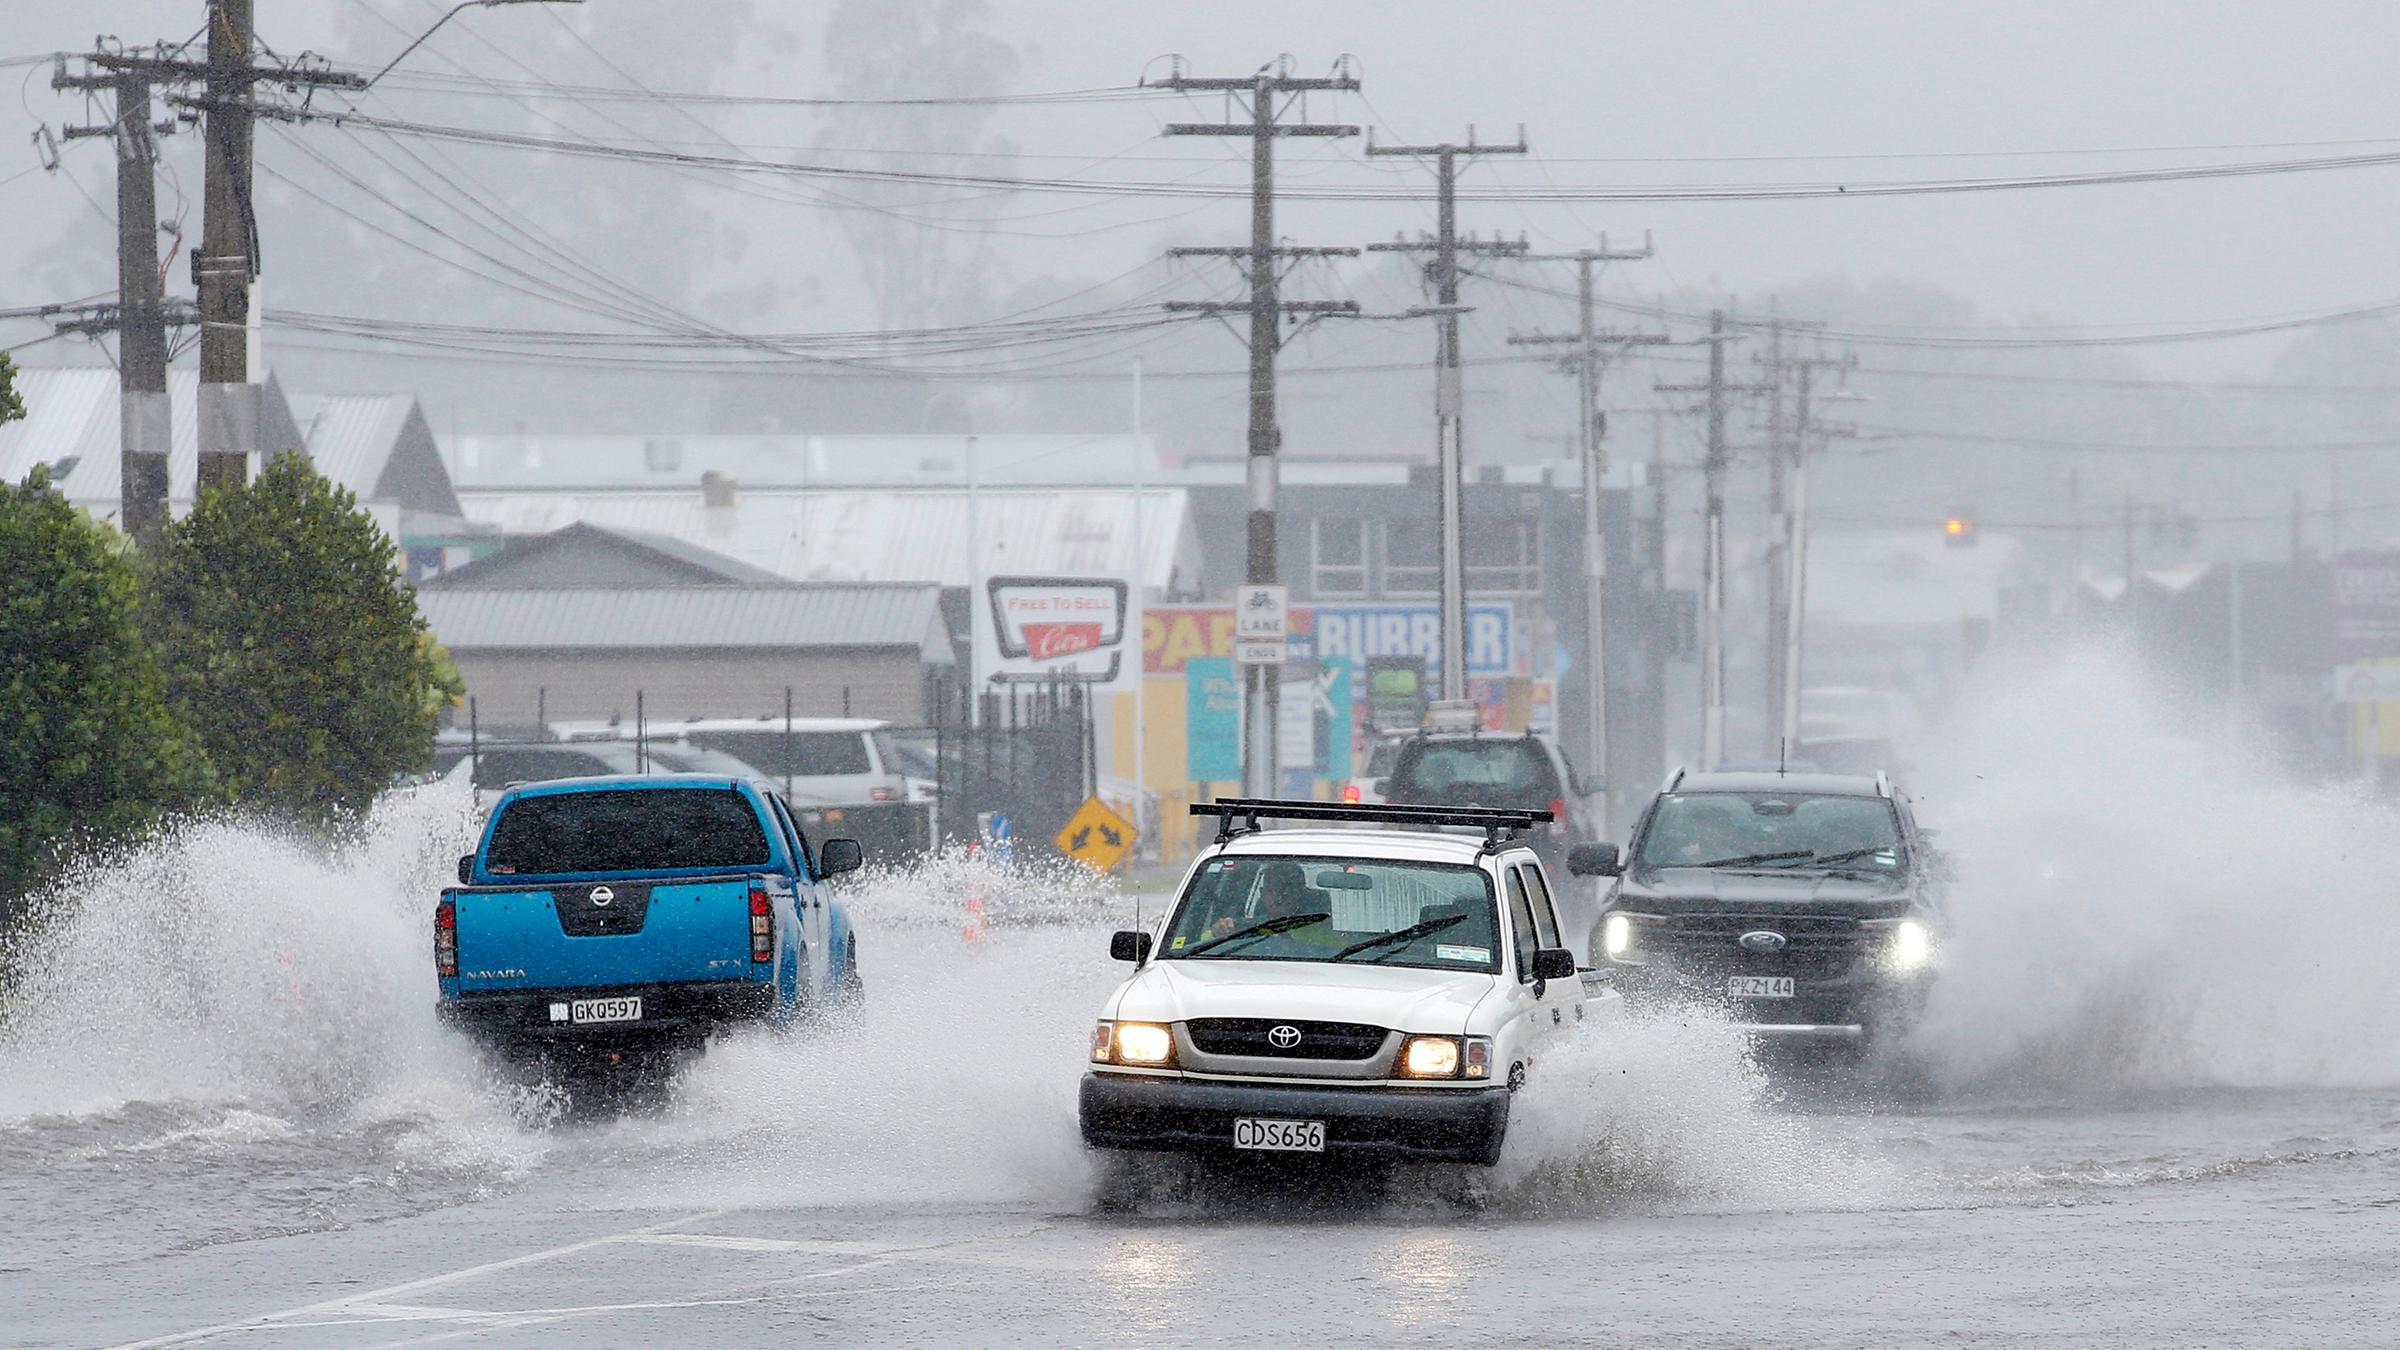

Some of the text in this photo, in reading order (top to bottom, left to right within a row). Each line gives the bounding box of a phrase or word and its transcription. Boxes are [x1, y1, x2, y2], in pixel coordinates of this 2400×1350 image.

[1008, 597, 1047, 609] FREE
[1075, 597, 1111, 609] SELL
[1241, 619, 1280, 632] LANE
[1318, 613, 1503, 664] RUBBR
[1247, 646, 1276, 657] ENDS
[467, 969, 526, 979] NAVARA
[575, 1001, 638, 1020] GKQ597
[1237, 1123, 1321, 1147] CDS656
